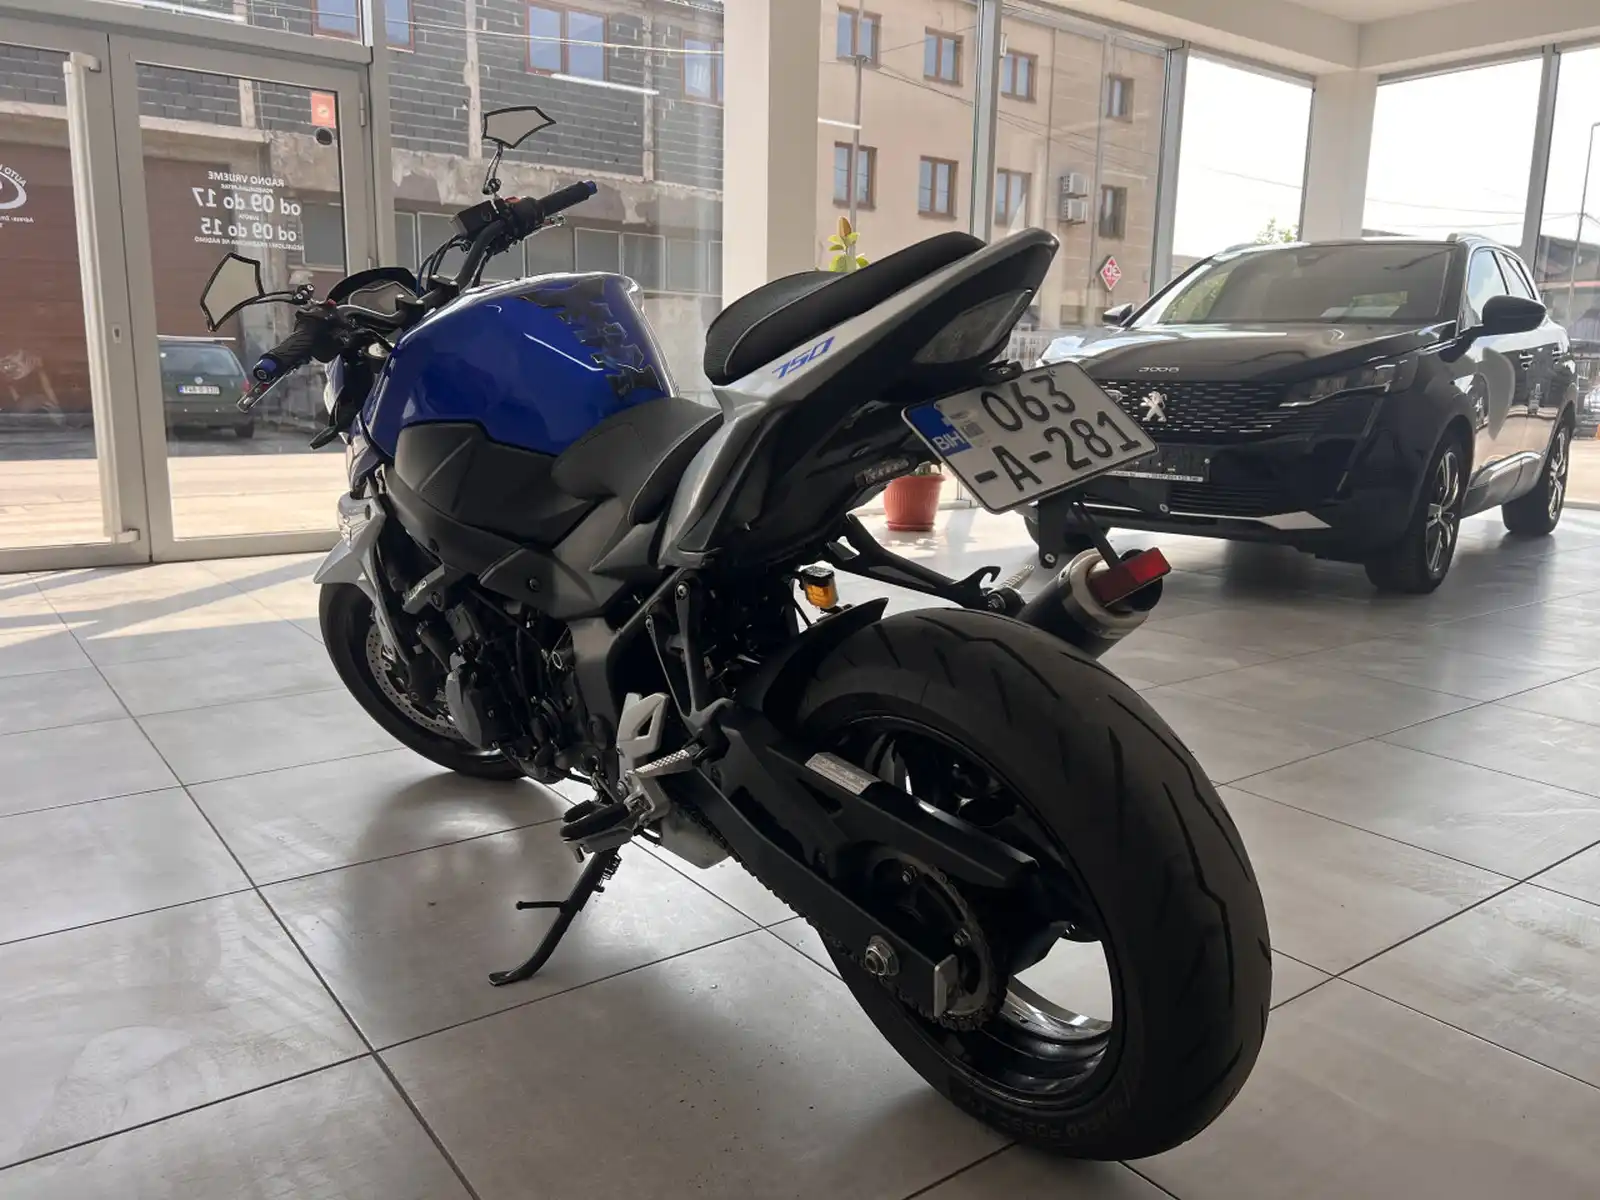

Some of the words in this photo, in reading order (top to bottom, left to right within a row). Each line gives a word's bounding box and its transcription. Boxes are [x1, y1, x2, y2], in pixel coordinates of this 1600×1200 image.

[771, 336, 836, 379] 750
[980, 374, 1076, 432] 063
[931, 431, 966, 452] BIH
